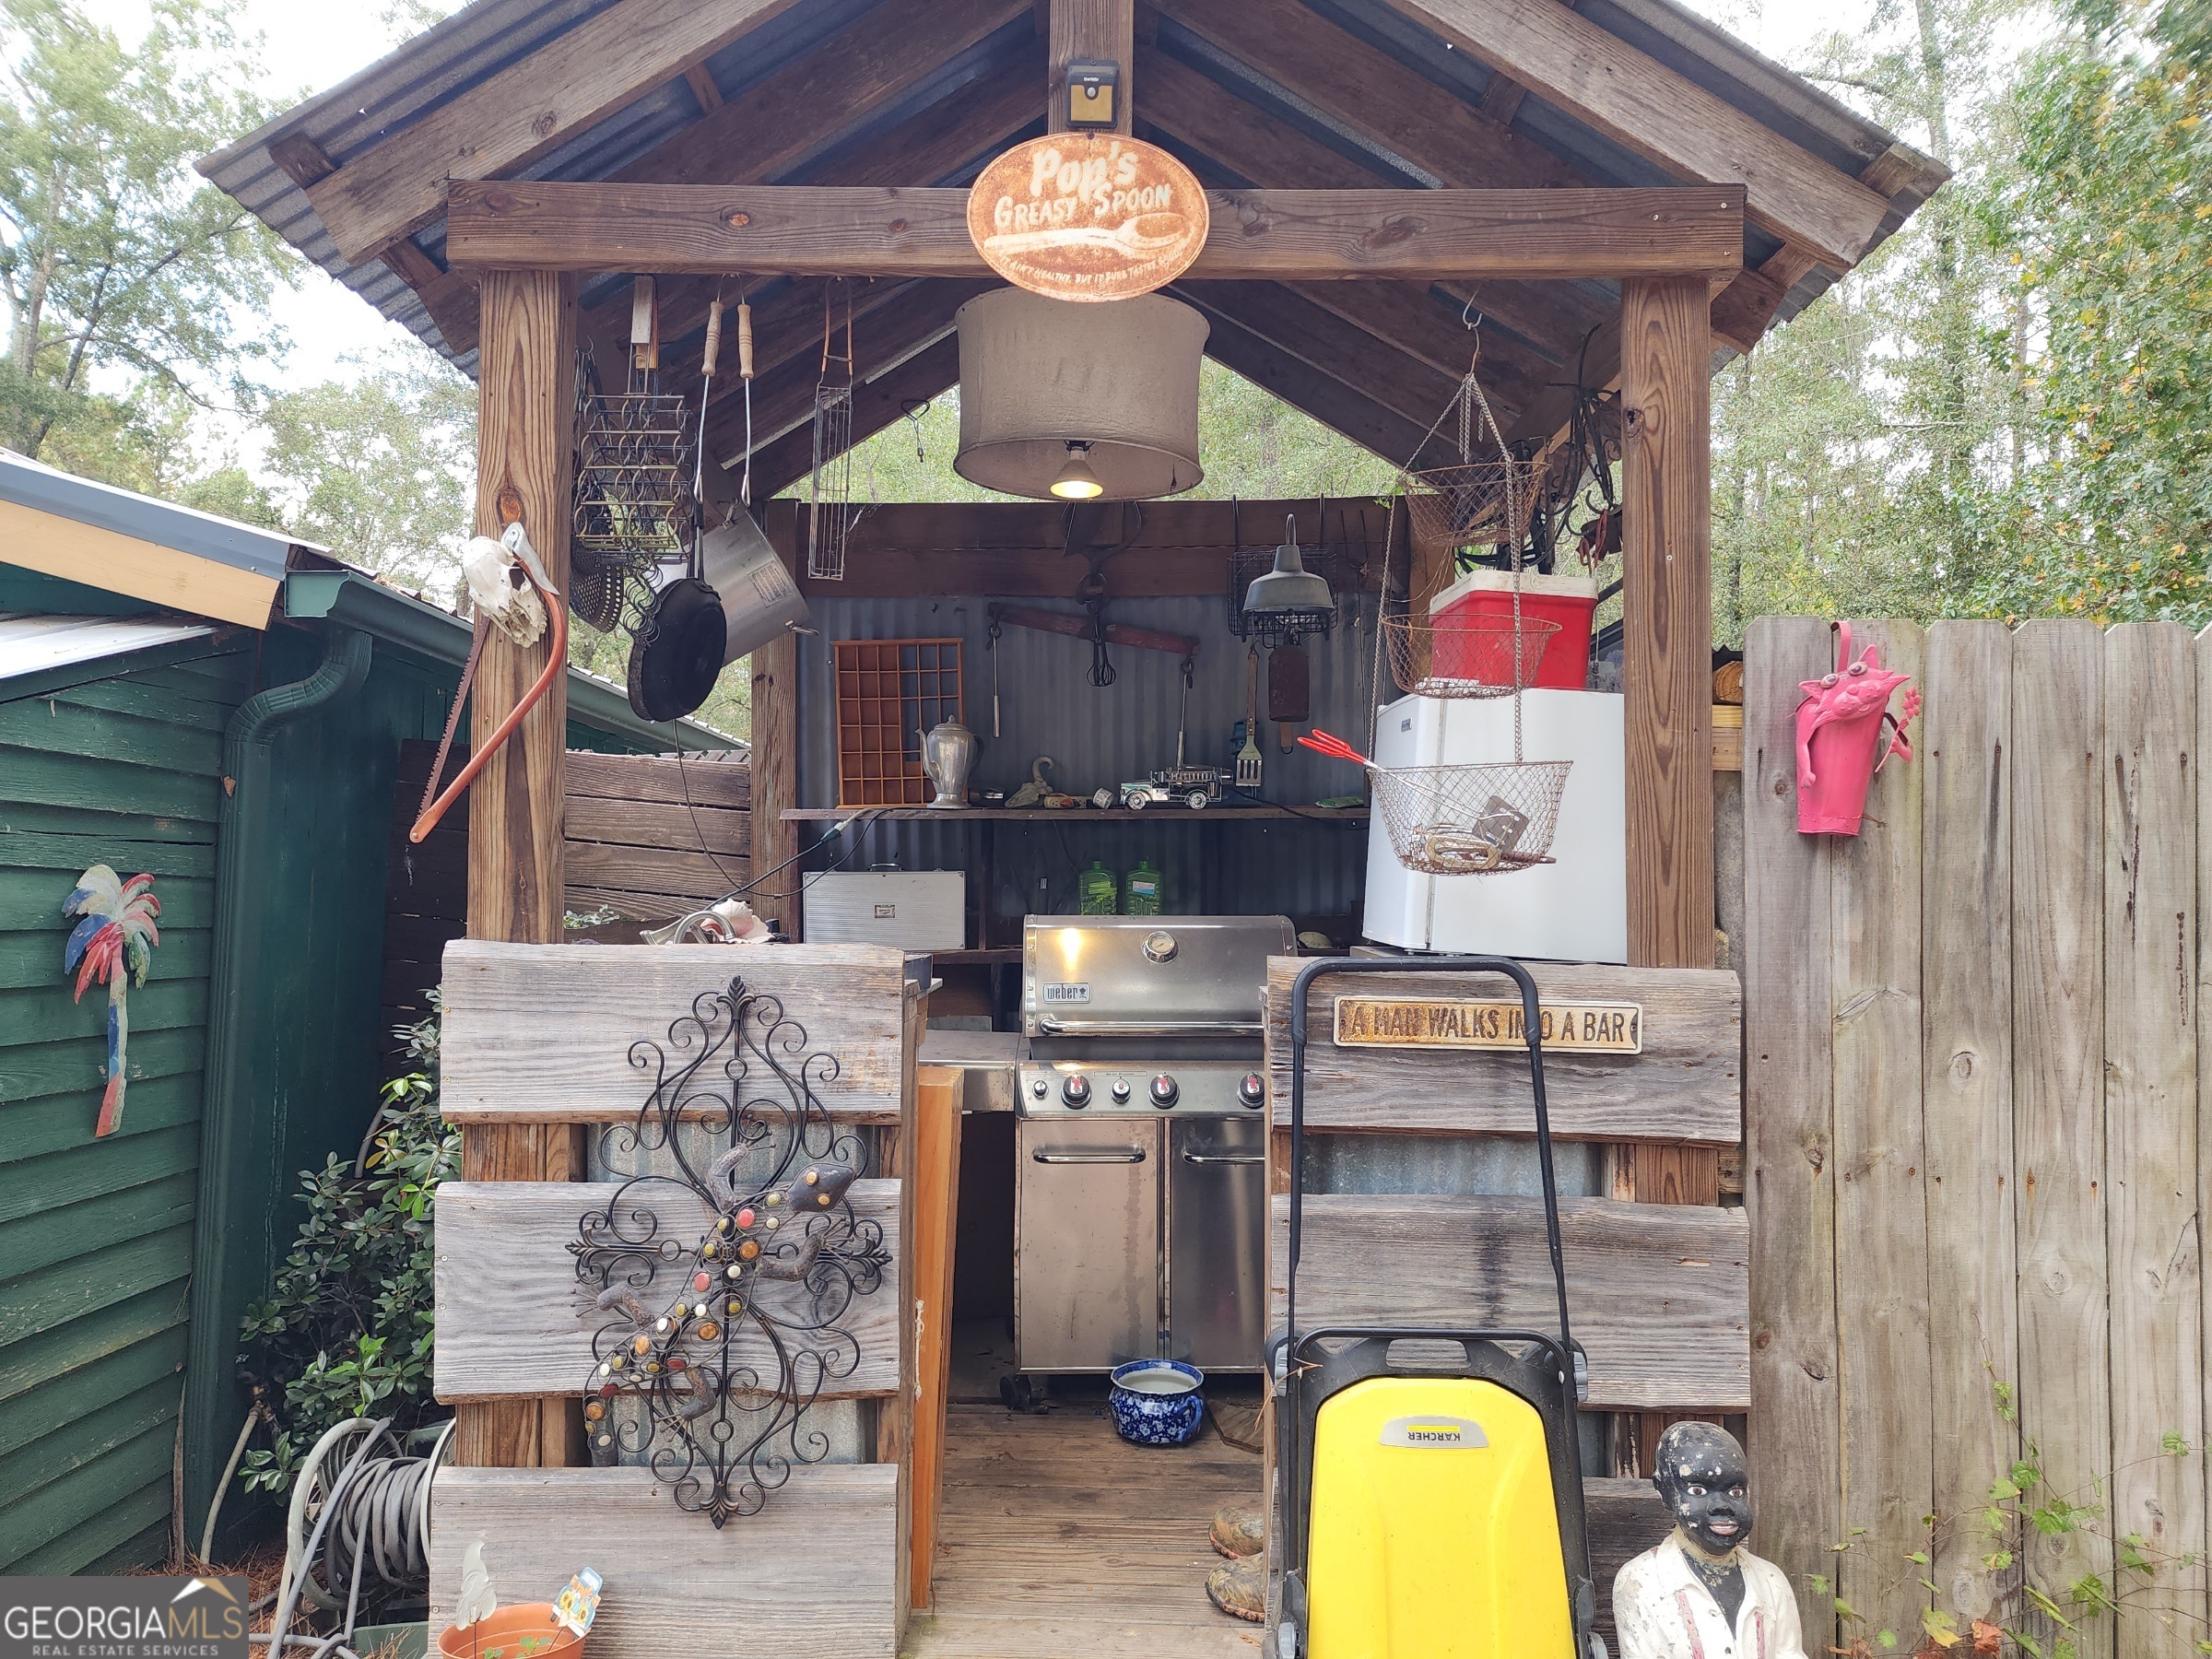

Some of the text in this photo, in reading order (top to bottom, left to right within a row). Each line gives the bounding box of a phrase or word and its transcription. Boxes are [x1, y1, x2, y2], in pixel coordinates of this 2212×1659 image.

[1030, 141, 1138, 202] Pop's
[994, 182, 1171, 229] GREASY SPOON
[1075, 273, 1093, 284] BUT
[1047, 983, 1077, 1000] weber
[1351, 1006, 1625, 1042] A MAN WALKS INO A BAR
[1407, 1431, 1461, 1441] KÄRCHER
